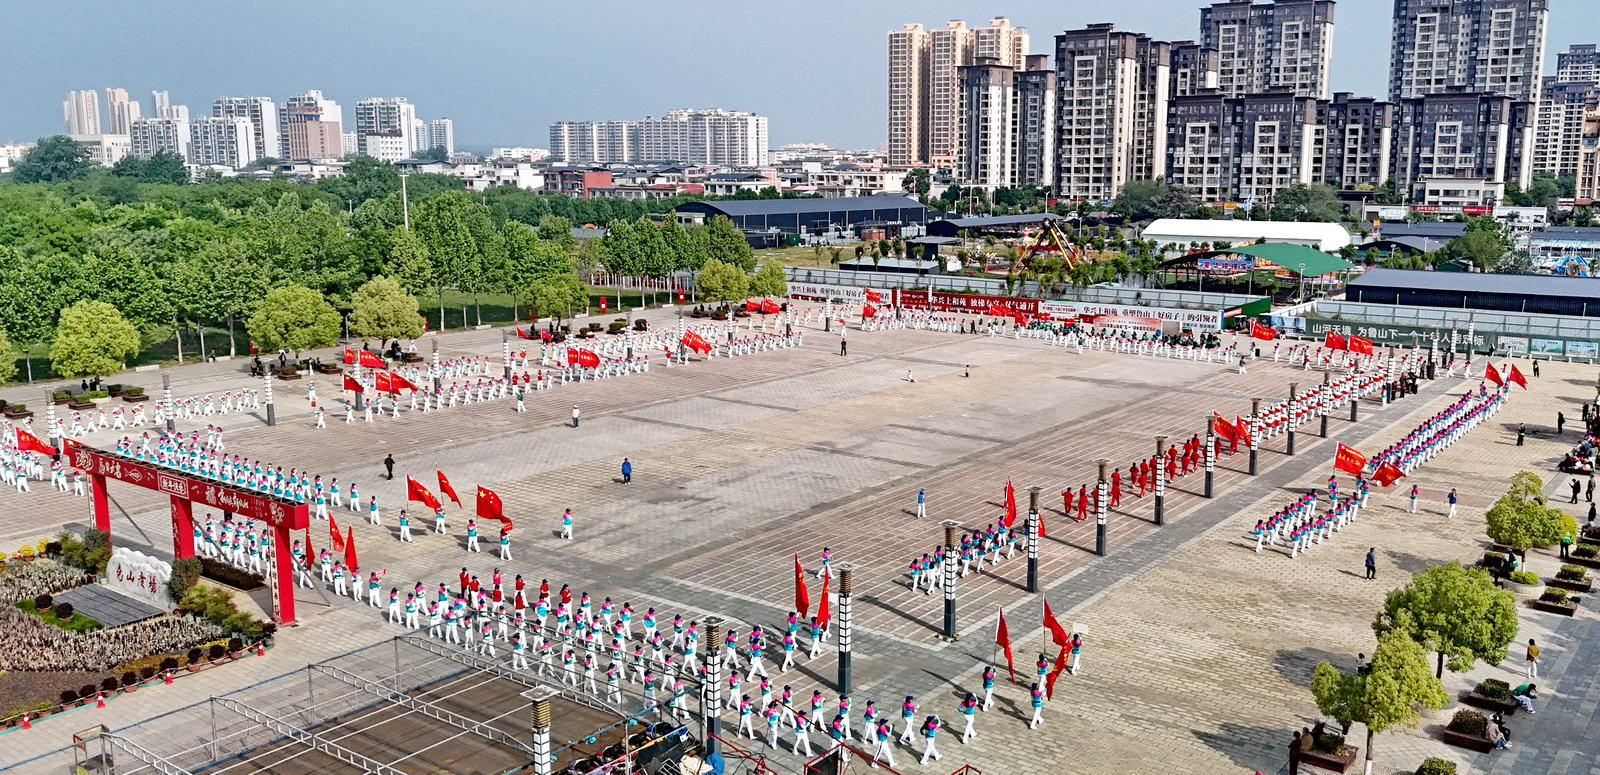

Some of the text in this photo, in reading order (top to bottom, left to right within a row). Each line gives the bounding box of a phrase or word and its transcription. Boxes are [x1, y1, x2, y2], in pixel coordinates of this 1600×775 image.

[1084, 306, 1118, 317] 华兴上和苑
[1312, 323, 1351, 336] 山河天境
